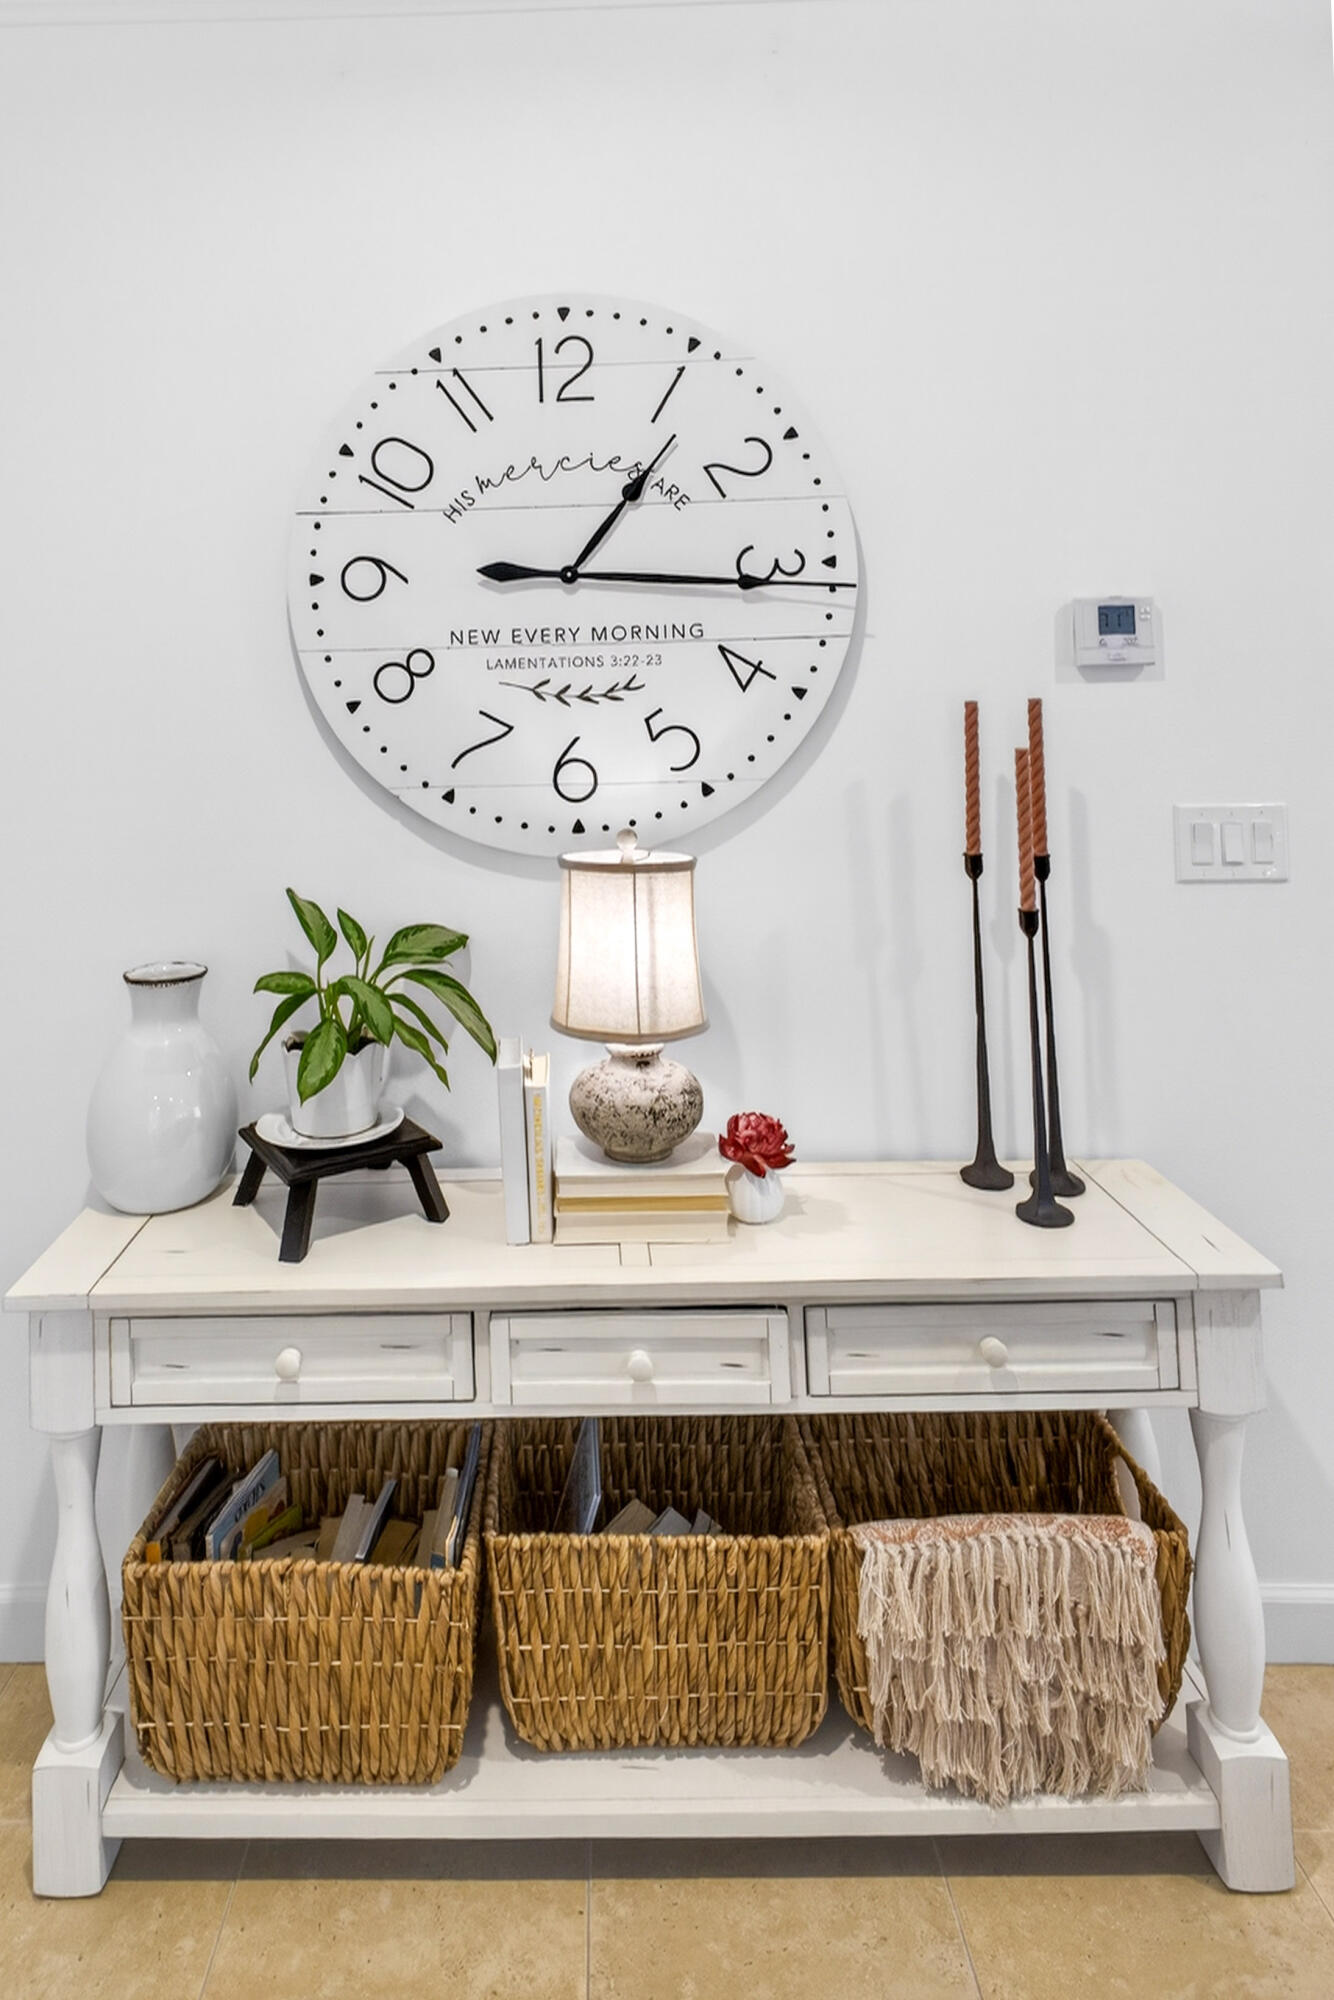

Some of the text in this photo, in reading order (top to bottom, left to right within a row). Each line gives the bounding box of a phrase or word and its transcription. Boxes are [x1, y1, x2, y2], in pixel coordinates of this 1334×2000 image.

[435, 367, 494, 433] 11
[534, 335, 595, 404] 12
[650, 365, 686, 424] 1
[358, 436, 435, 510] 10
[442, 451, 692, 524] HIS mercies ARE
[702, 436, 773, 499] 2
[340, 555, 409, 603] 9
[735, 543, 806, 584] 3
[450, 623, 704, 646] NEW EVERY MORNING
[486, 653, 663, 671] LAMENTATIONS 3:22-23
[372, 647, 436, 705] 8
[717, 643, 777, 693] 4
[450, 709, 515, 770] 7
[552, 736, 599, 804] 6
[643, 707, 701, 772] 5
